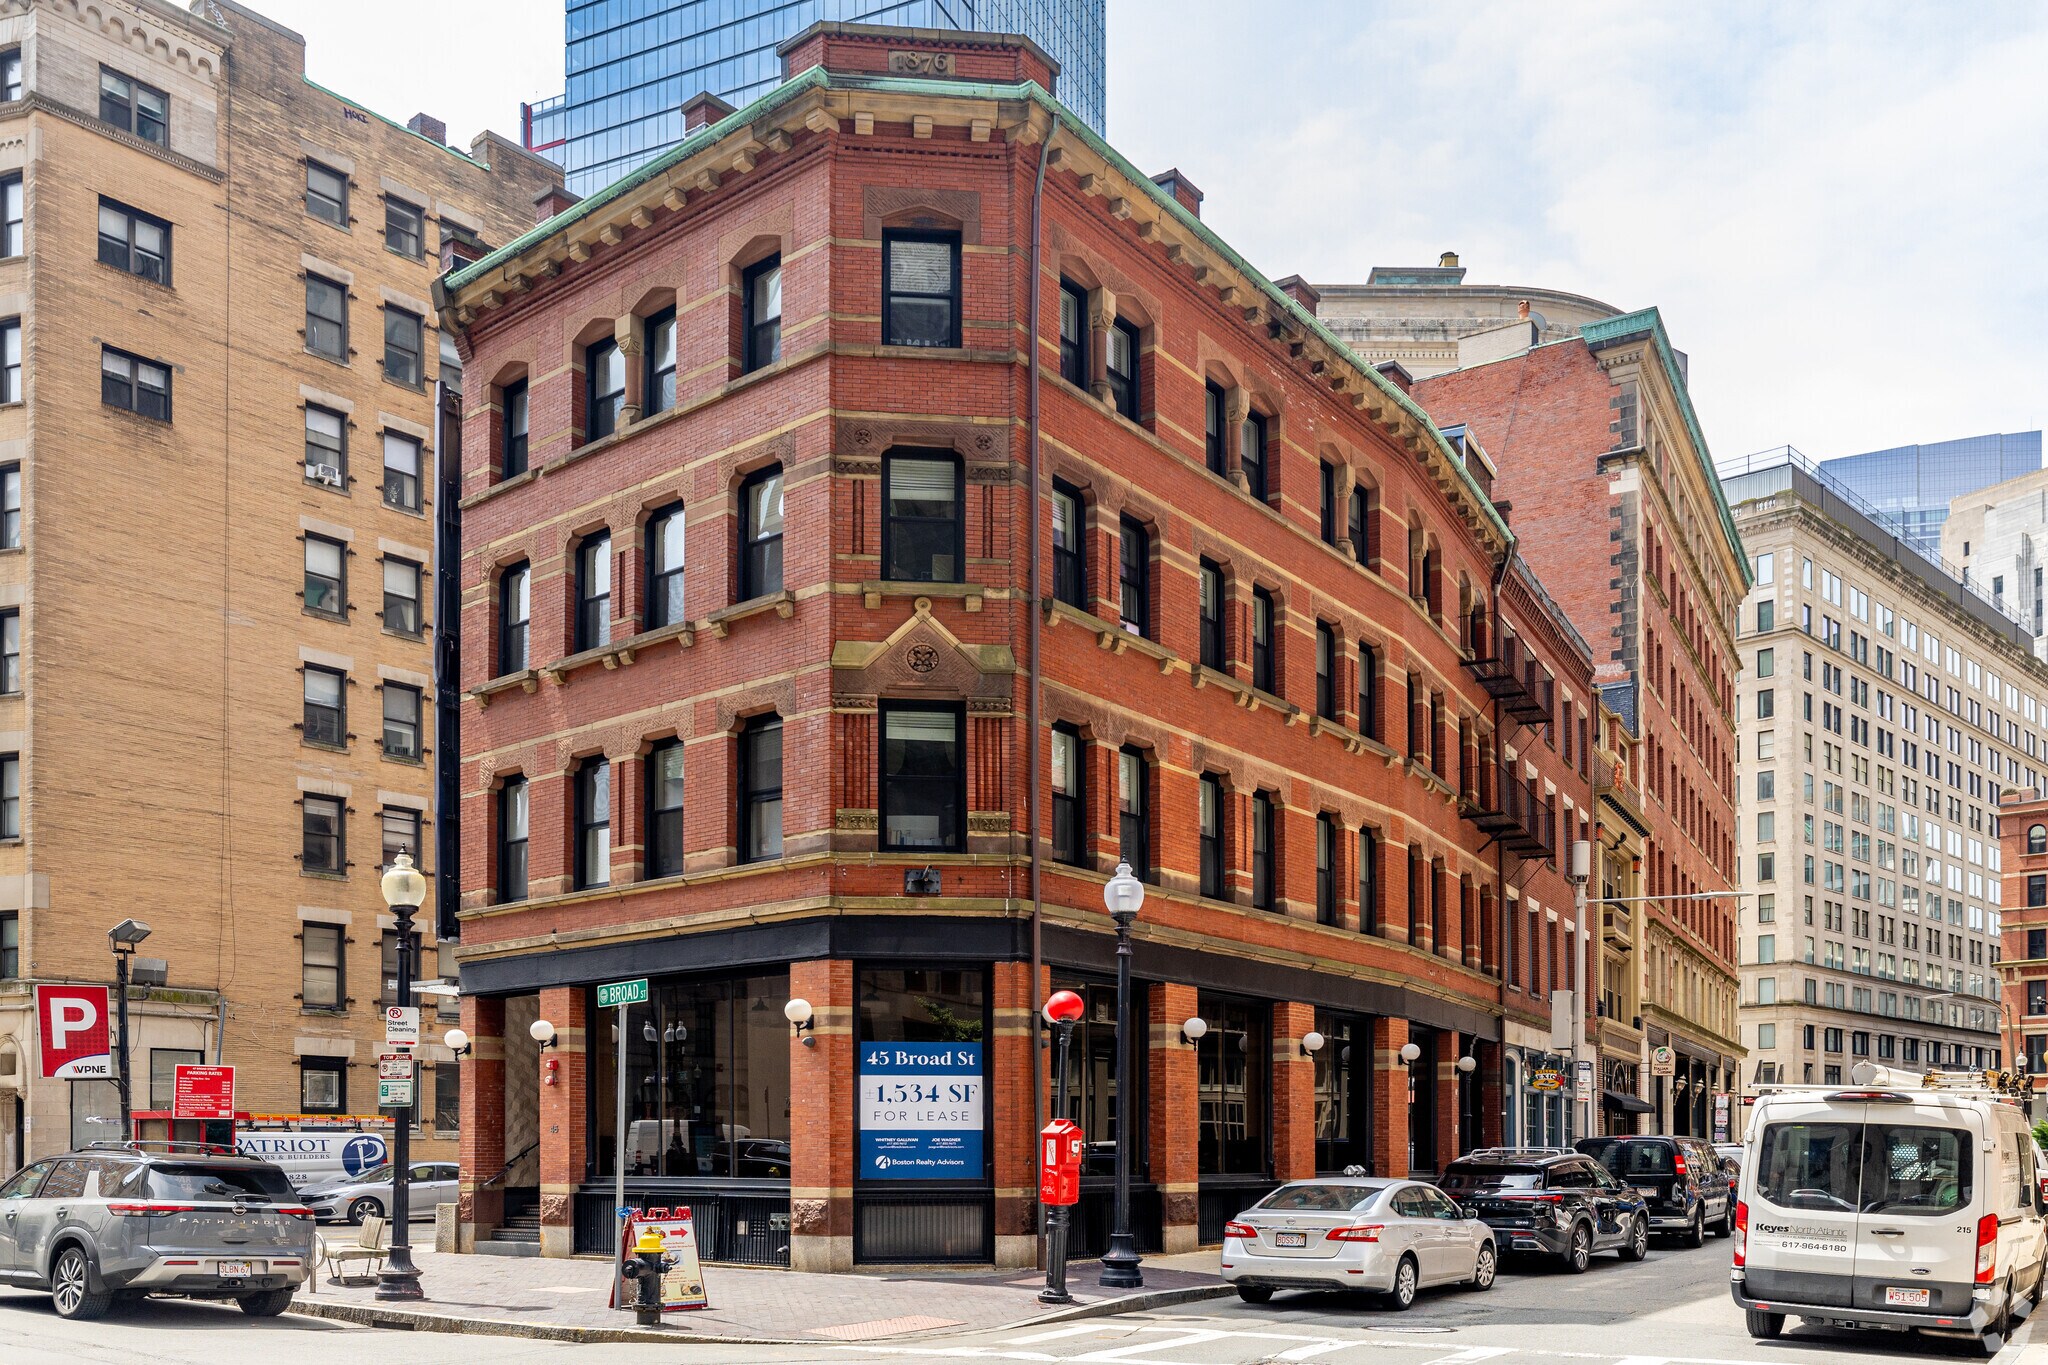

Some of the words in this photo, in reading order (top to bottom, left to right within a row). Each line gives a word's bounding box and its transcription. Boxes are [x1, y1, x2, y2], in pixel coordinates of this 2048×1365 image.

[895, 51, 947, 72] 1876
[610, 984, 639, 1002] BROAD
[640, 990, 646, 998] ST
[50, 998, 97, 1049] P
[866, 1050, 890, 1066] 45
[895, 1050, 952, 1066] Broad
[957, 1050, 976, 1066] St
[77, 1065, 106, 1073] VPNE
[948, 1084, 978, 1103] SF
[873, 1111, 908, 1121] FOR
[917, 1111, 969, 1121] LEASE
[179, 1218, 291, 1226] PATHFINDER
[1756, 1223, 1789, 1233] Keyes
[1790, 1225, 1815, 1235] North
[1816, 1227, 1848, 1237] Atlantic
[1781, 1241, 1847, 1252] 617-964-6180
